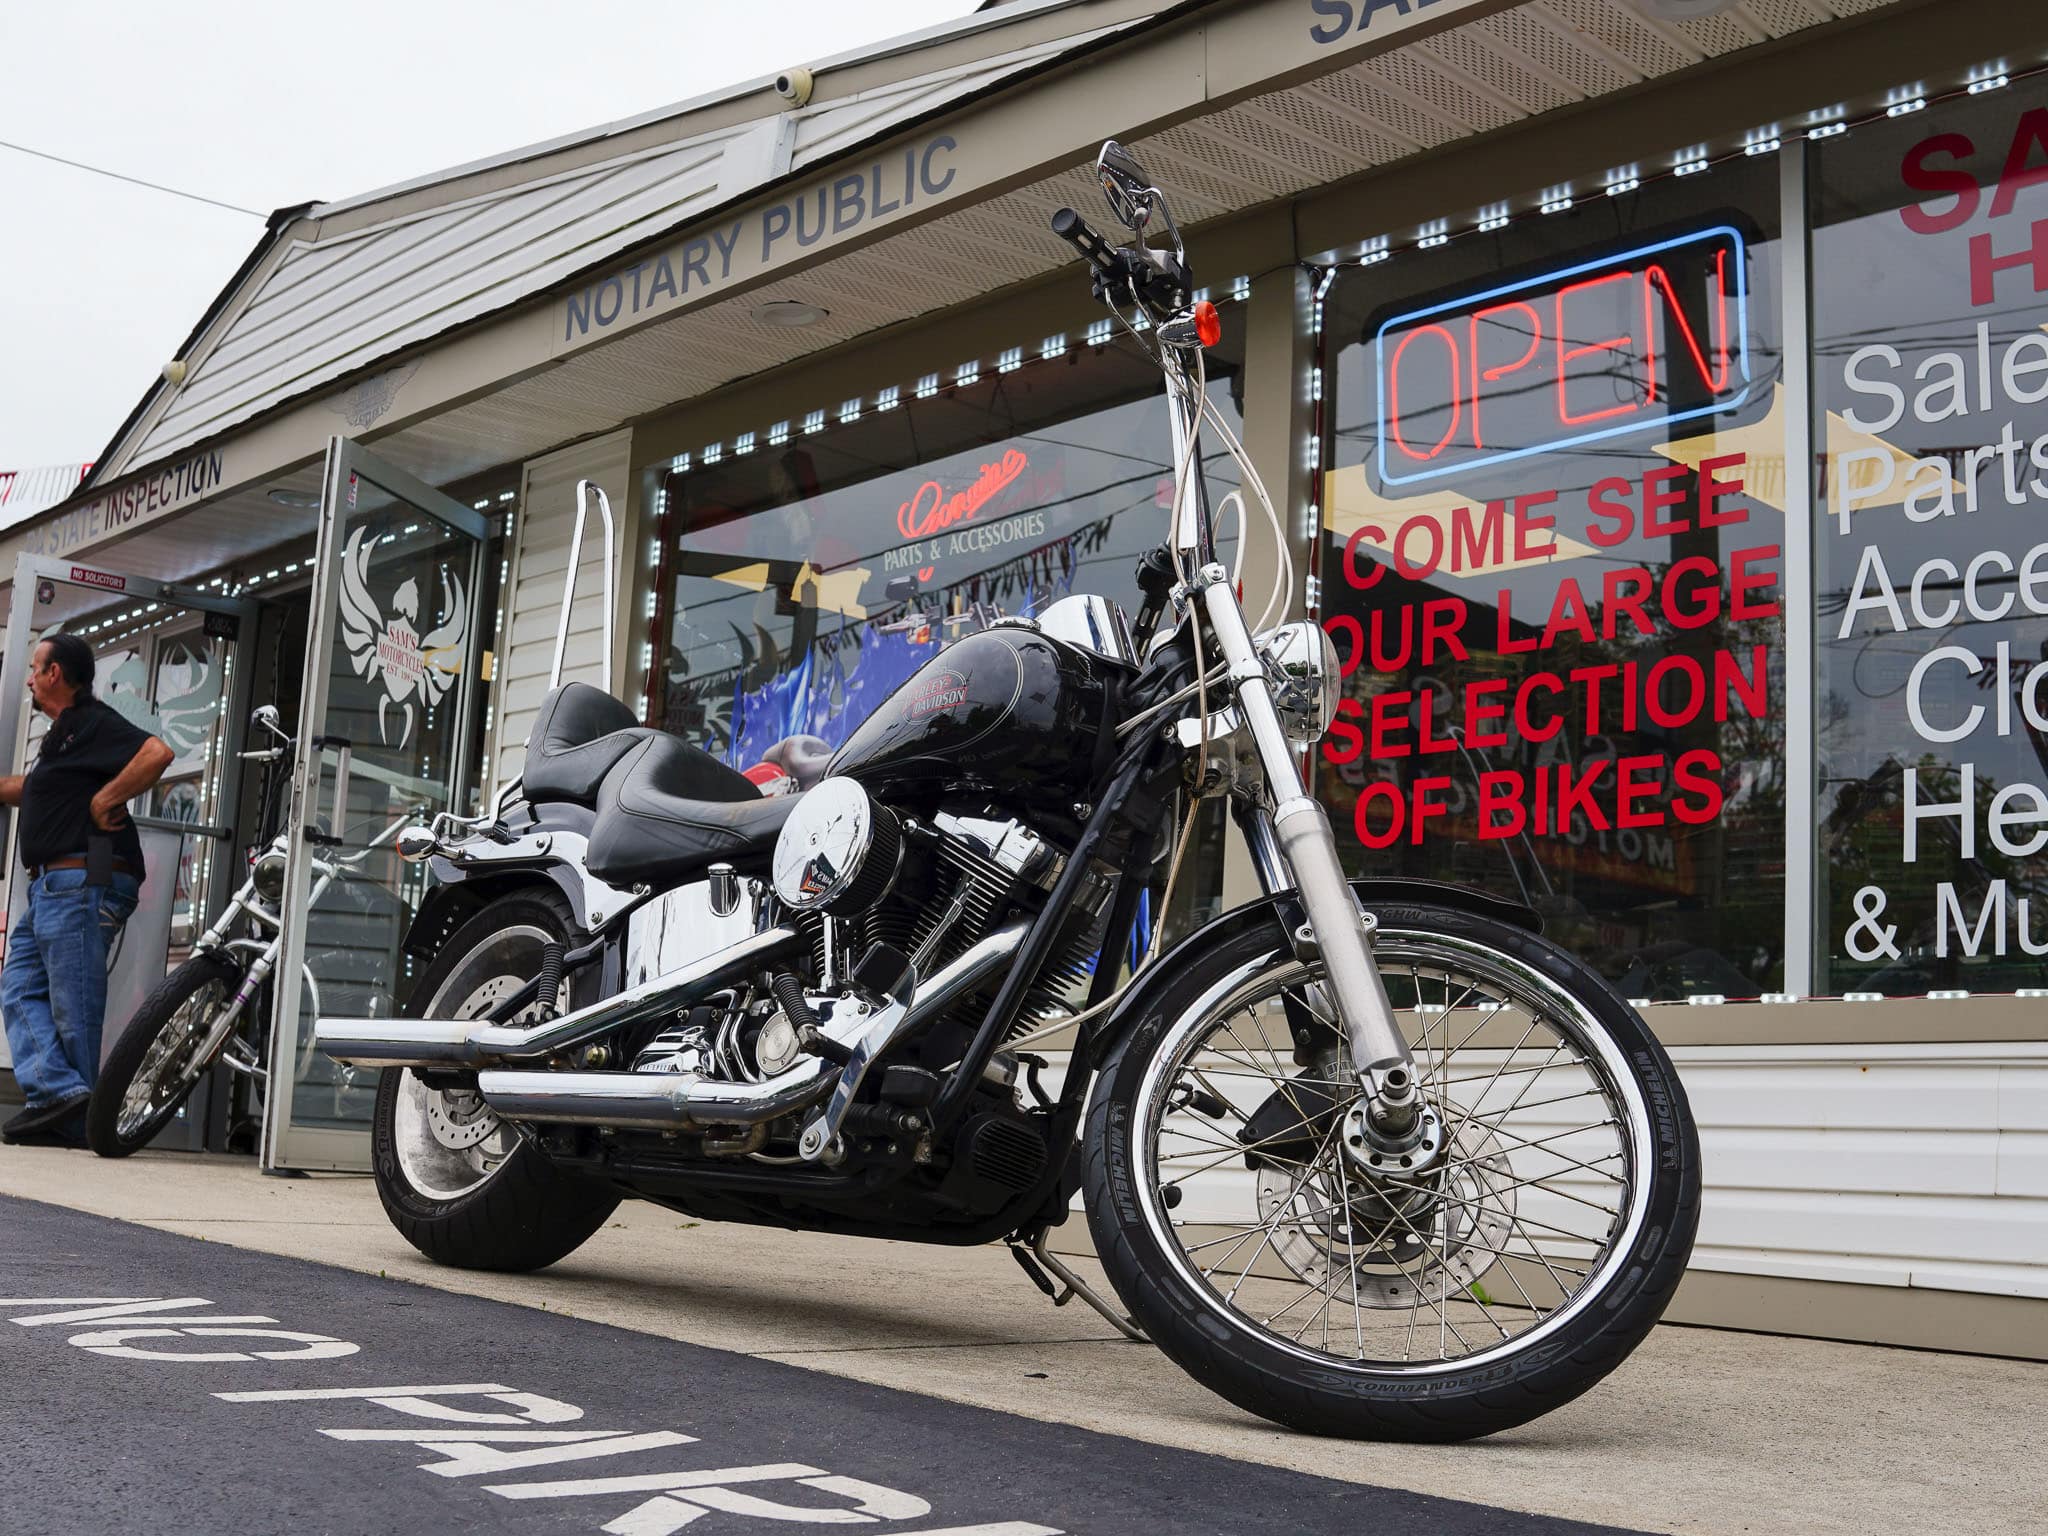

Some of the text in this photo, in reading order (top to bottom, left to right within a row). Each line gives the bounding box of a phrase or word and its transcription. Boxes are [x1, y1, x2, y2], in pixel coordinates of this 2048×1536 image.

[565, 136, 957, 341] NOTARY PUBLIC
[1391, 248, 1727, 460] OPEN
[49, 502, 101, 554] STATE
[104, 449, 224, 531] INSPECTION
[884, 513, 1045, 572] PARTS & ACCESSORIES
[1343, 452, 1749, 590] COME SEE
[73, 569, 124, 588] NO SOLICITORS
[1323, 544, 1781, 680] OUR LARGE
[379, 641, 424, 675] MOTORCYCLES
[389, 625, 417, 652] SAM'S
[913, 689, 965, 714] DAVIDSON
[1322, 644, 1768, 765] SELECTION
[1354, 749, 1723, 850] OF BIKES
[1844, 885, 1902, 962] &
[377, 1071, 394, 1139] OMMANDER
[1634, 1049, 1676, 1145] MICHELIN
[1111, 1126, 1140, 1224] MICHELIN
[0, 1297, 1067, 1536] NO PAR
[1353, 1374, 1484, 1393] COMMANDER
